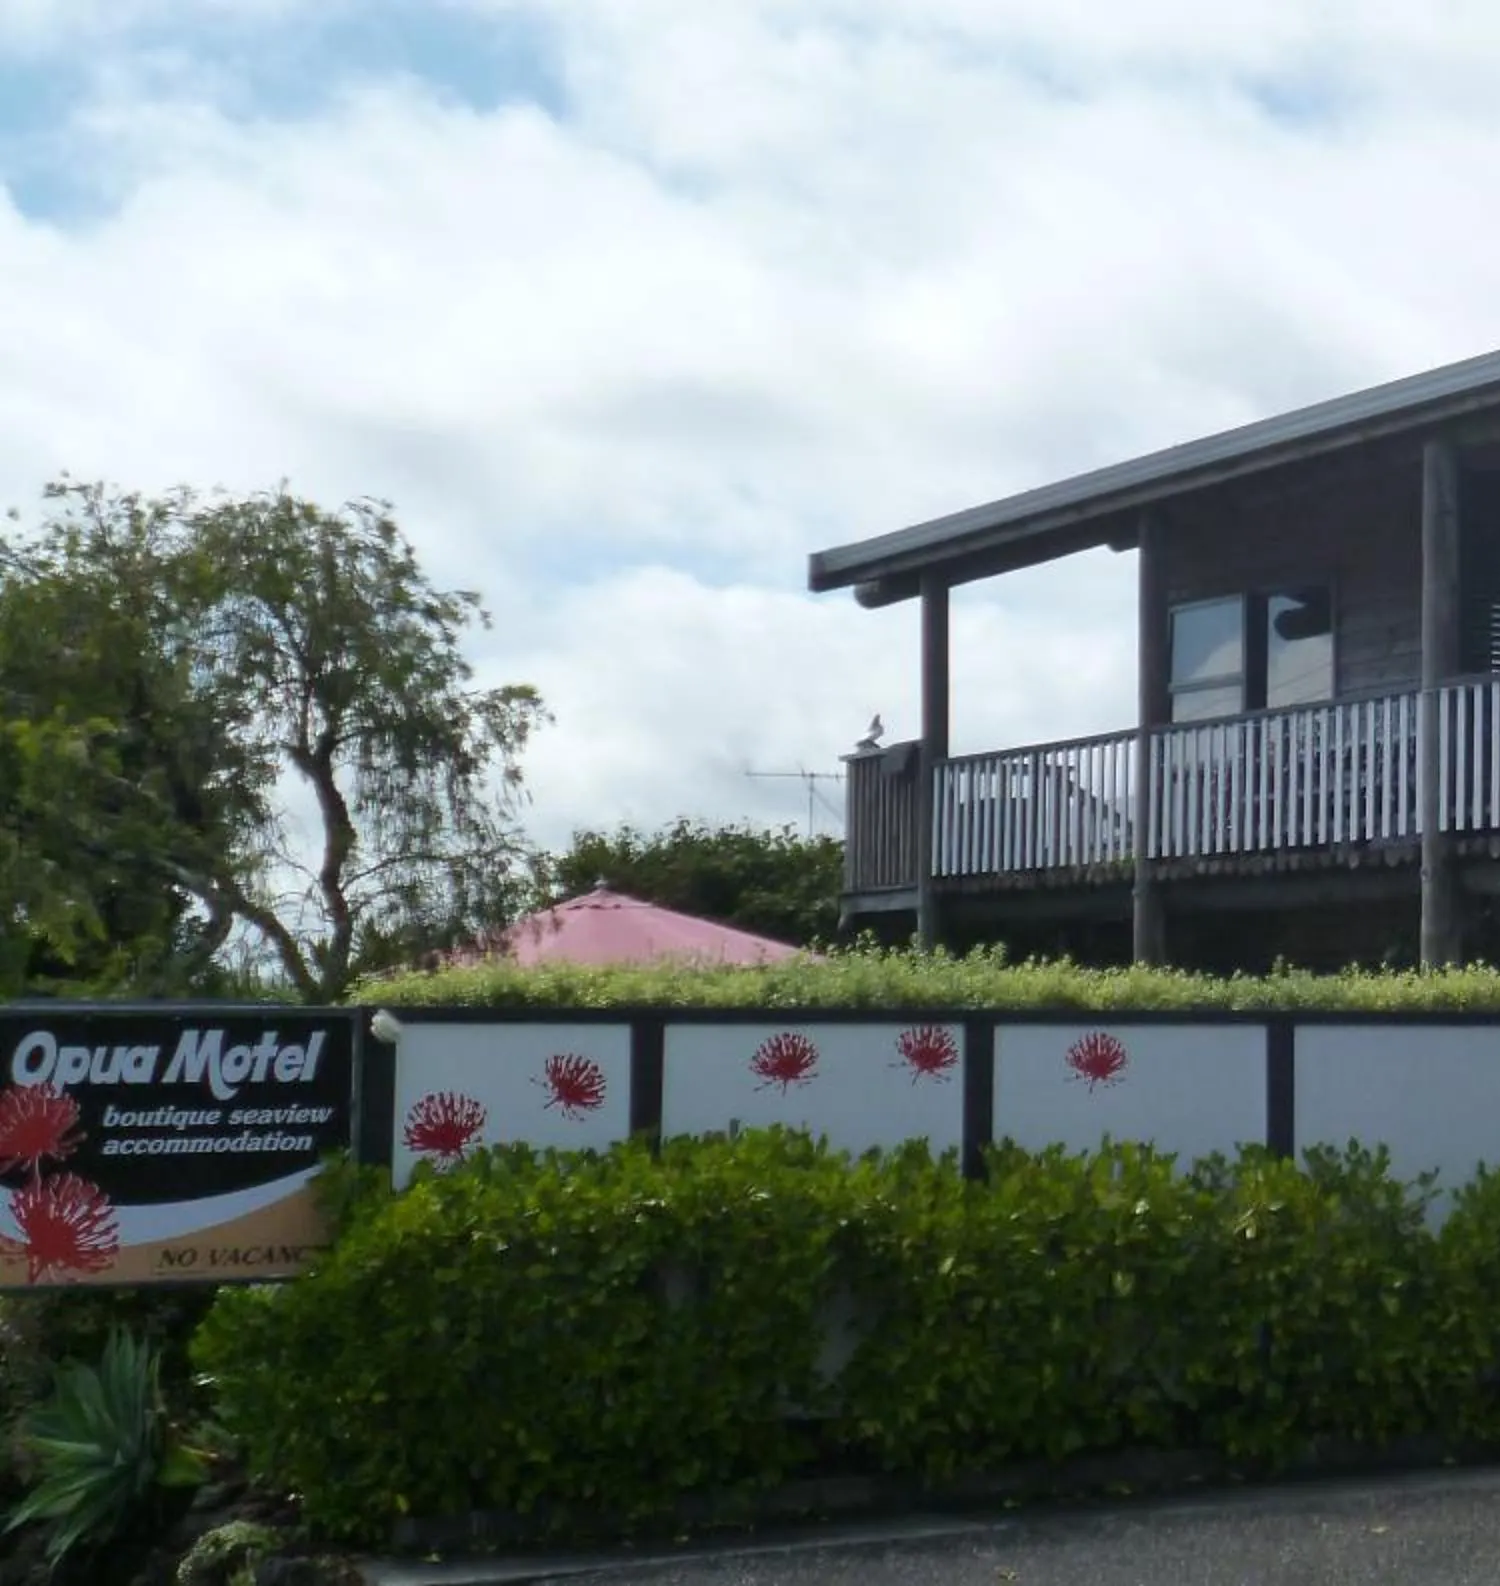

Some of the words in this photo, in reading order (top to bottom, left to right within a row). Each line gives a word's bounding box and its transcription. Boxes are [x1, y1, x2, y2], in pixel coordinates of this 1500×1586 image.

[13, 1031, 160, 1098] Opua
[162, 1029, 326, 1100] Motel
[103, 1105, 221, 1130] boutique
[228, 1104, 334, 1125] seaview
[103, 1131, 313, 1155] accommodation
[159, 1247, 198, 1267] NO
[208, 1245, 312, 1266] VACANC
